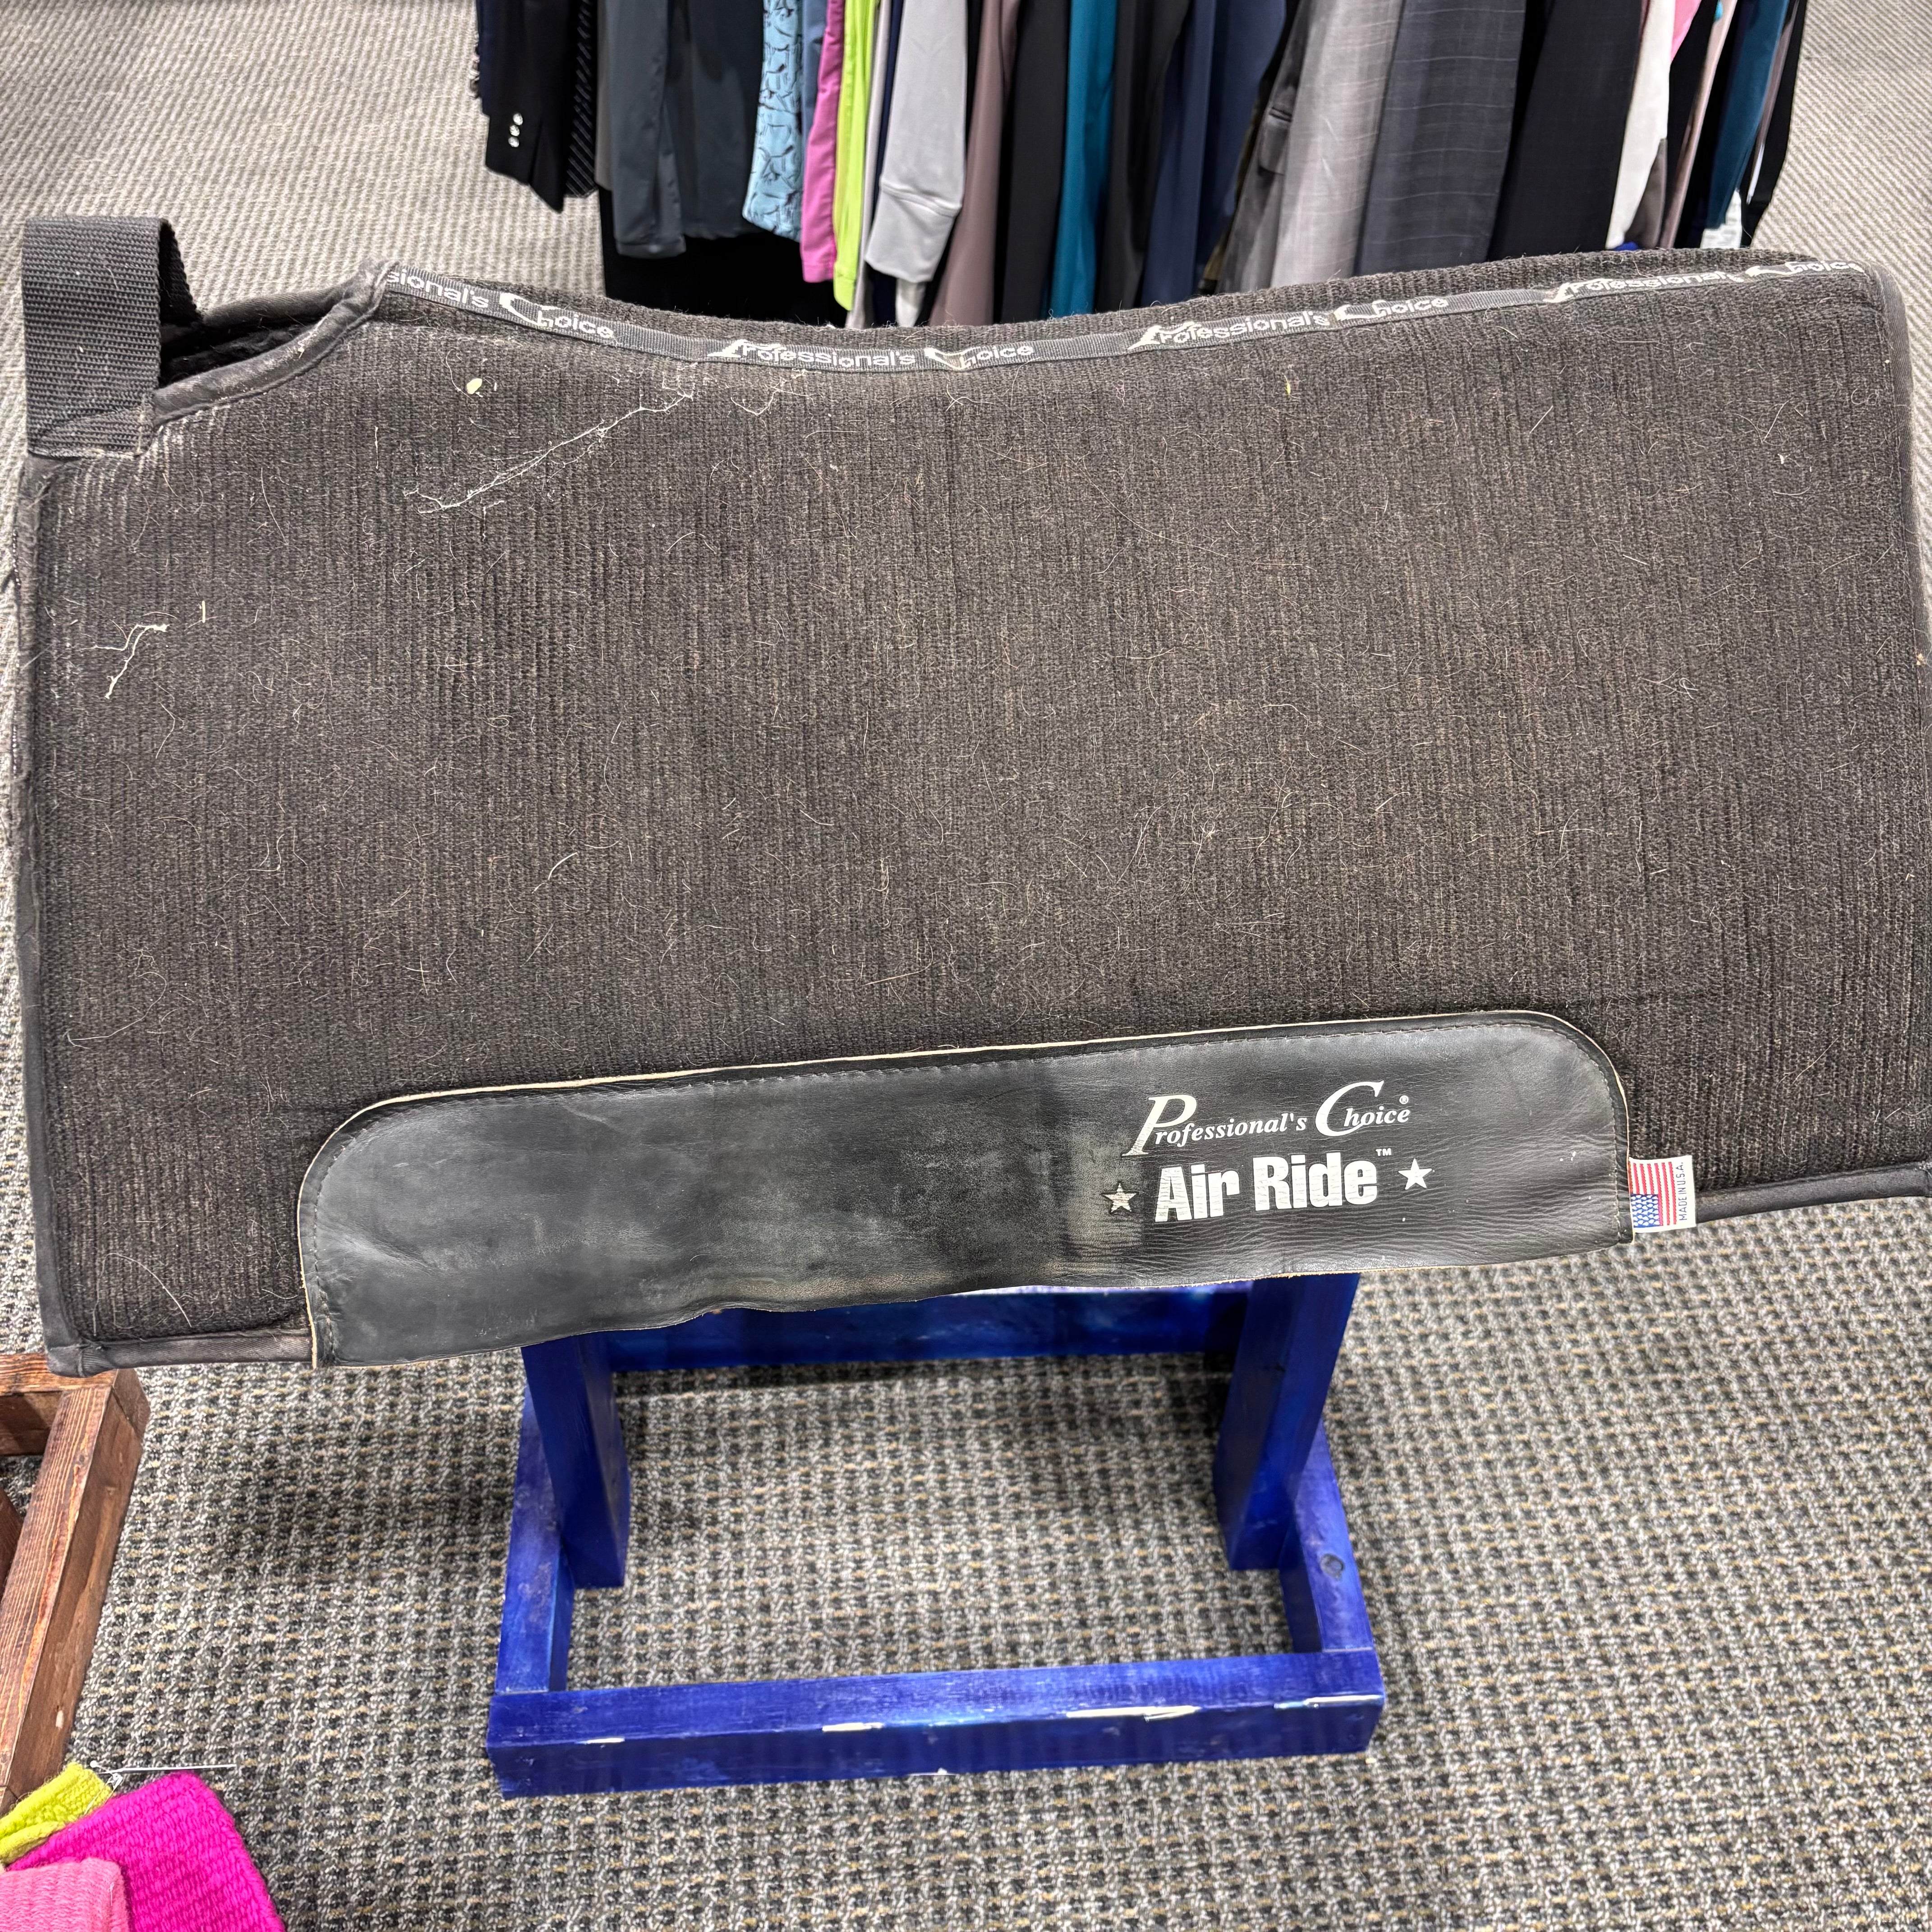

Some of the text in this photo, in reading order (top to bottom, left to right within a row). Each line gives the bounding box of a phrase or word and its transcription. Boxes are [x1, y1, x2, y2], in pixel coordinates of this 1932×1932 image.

[499, 291, 613, 338] Choice
[707, 339, 915, 368] Professional's
[1127, 310, 1330, 350] Professional's
[1121, 1094, 1307, 1156] Professional's
[1155, 1164, 1240, 1223] Air
[1678, 1196, 1688, 1221] MADE
